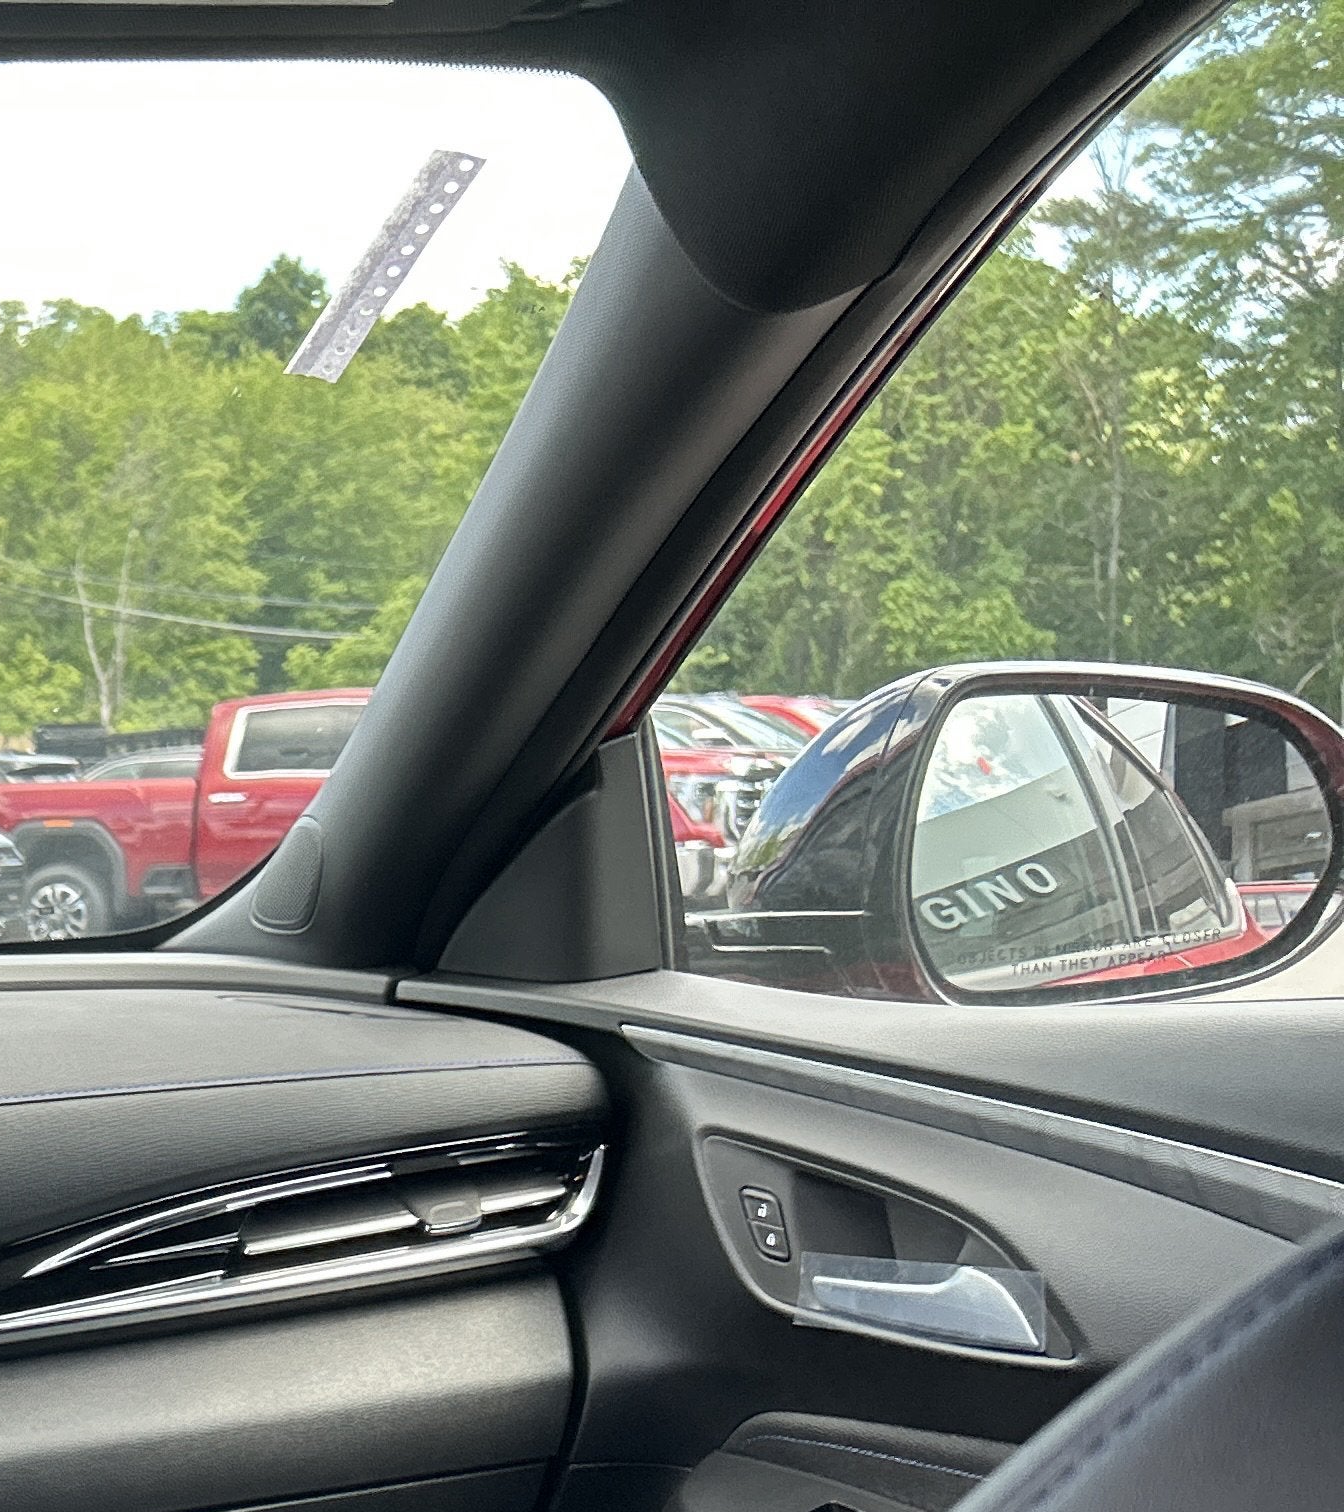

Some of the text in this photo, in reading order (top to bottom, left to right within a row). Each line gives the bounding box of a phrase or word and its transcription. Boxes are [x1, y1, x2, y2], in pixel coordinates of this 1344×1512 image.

[919, 862, 1058, 930] GINO
[1012, 960, 1052, 976] THAN
[1060, 957, 1099, 971] THEY
